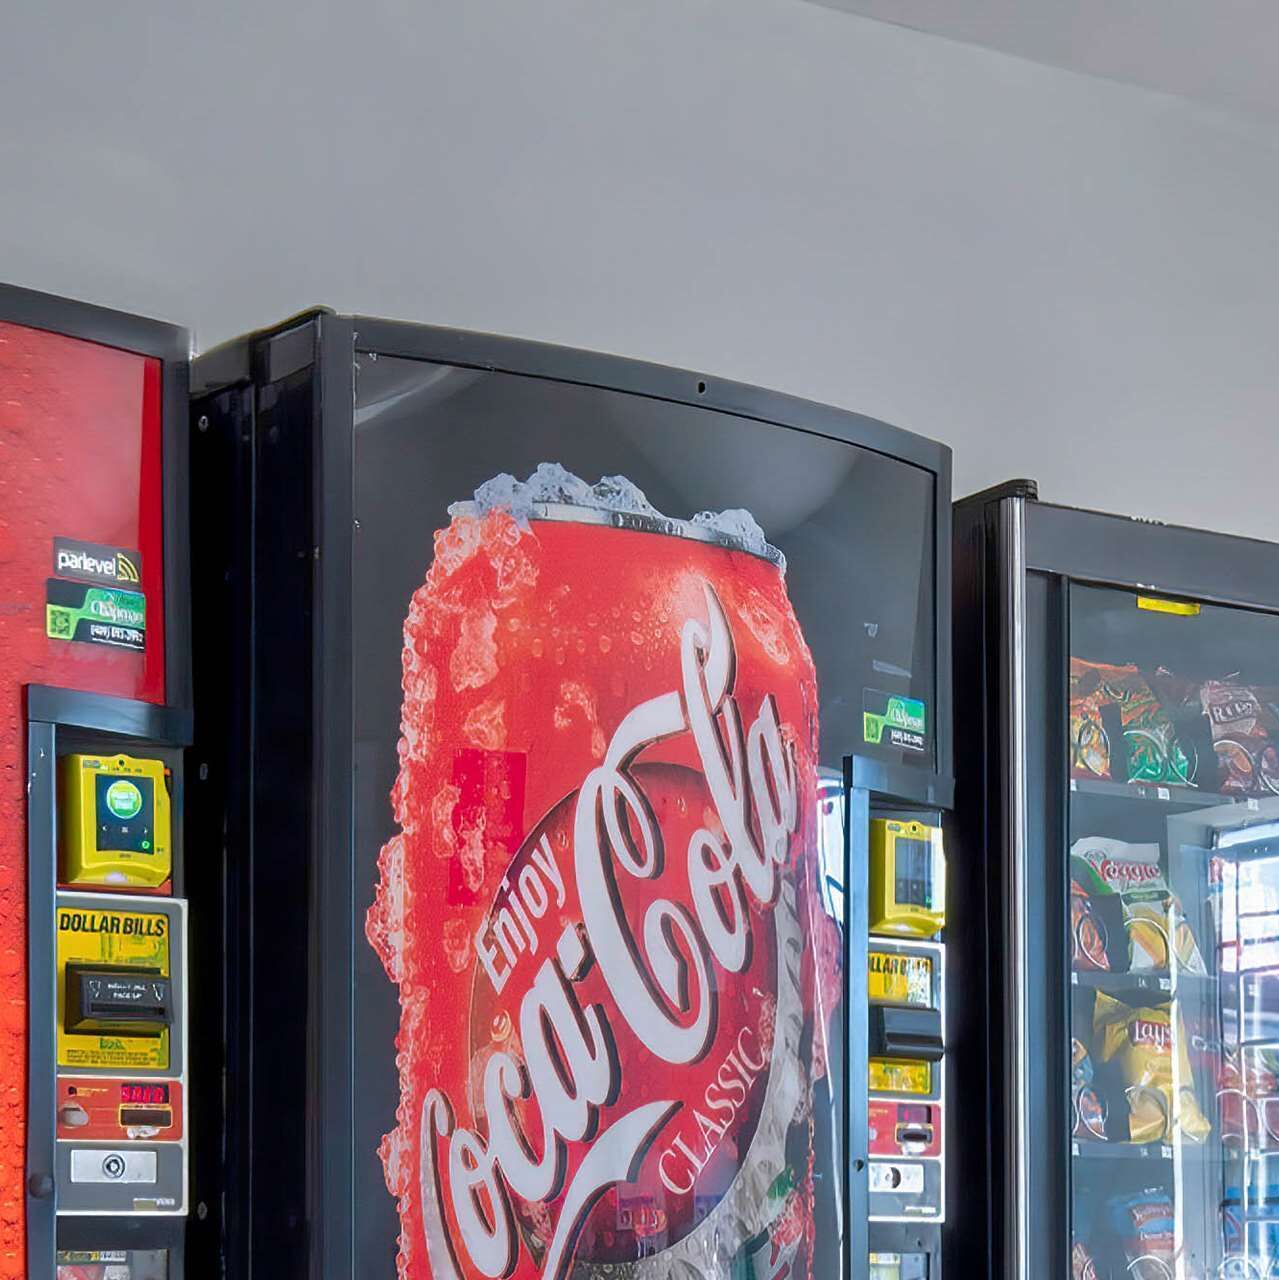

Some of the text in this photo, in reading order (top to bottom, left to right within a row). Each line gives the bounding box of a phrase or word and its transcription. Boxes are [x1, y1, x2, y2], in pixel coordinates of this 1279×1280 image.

[58, 551, 116, 577] parlevel
[59, 913, 166, 937] DOLLAR BILLS
[475, 832, 566, 996] Enjoy
[659, 1026, 767, 1196] CLASSIC
